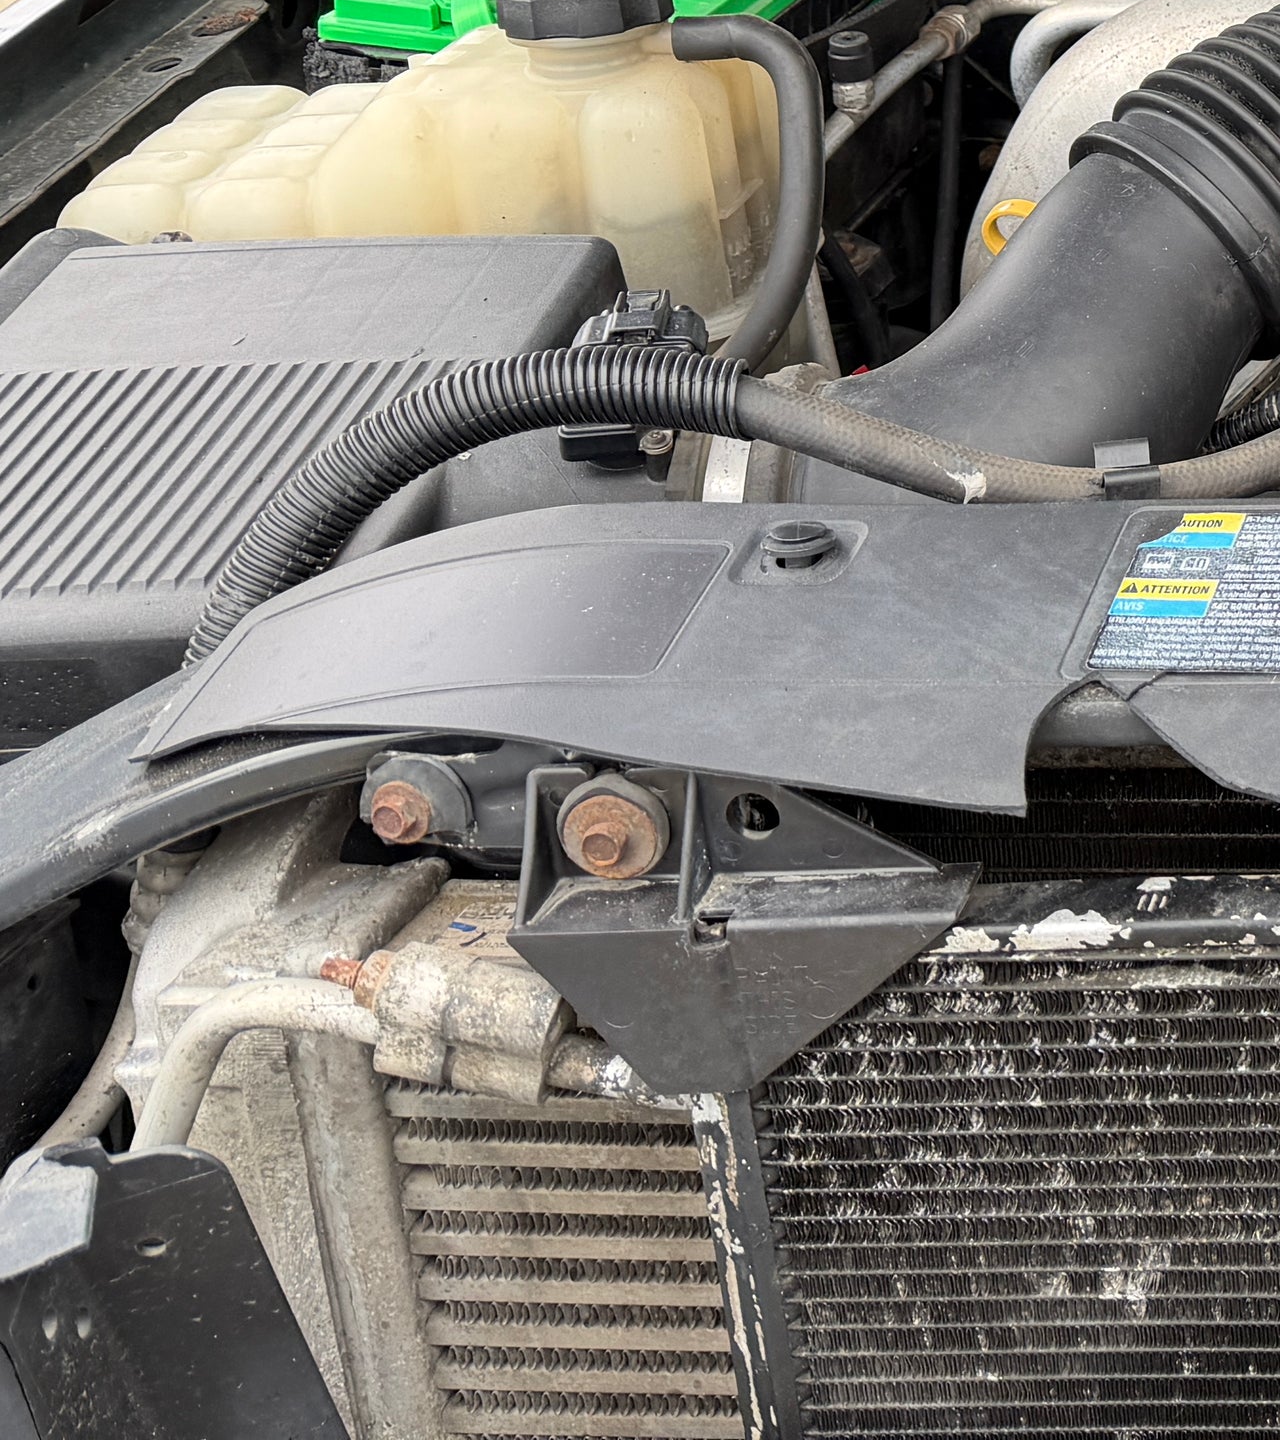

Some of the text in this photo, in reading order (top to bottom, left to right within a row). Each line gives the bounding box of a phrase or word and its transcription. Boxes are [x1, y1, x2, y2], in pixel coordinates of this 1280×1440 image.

[1180, 518, 1224, 529] AUTION
[1140, 584, 1210, 595] ATTENTION
[1114, 601, 1145, 611] AVIS
